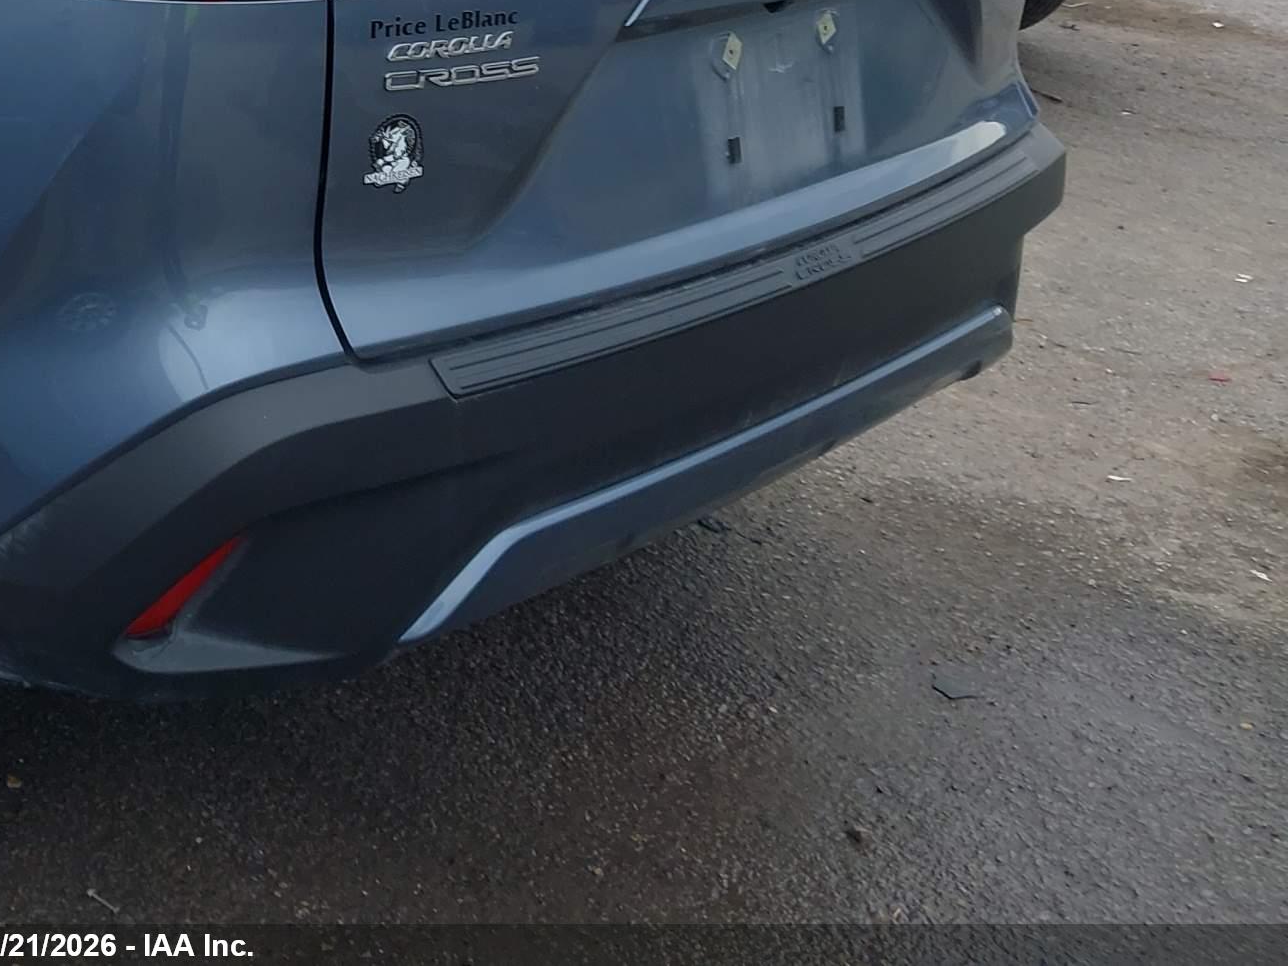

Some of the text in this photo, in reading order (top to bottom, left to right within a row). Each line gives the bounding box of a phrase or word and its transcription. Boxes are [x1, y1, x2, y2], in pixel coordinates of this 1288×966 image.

[370, 10, 520, 39] Price LeBlanc
[386, 30, 514, 62] COROLLA
[385, 56, 541, 91] CROSS
